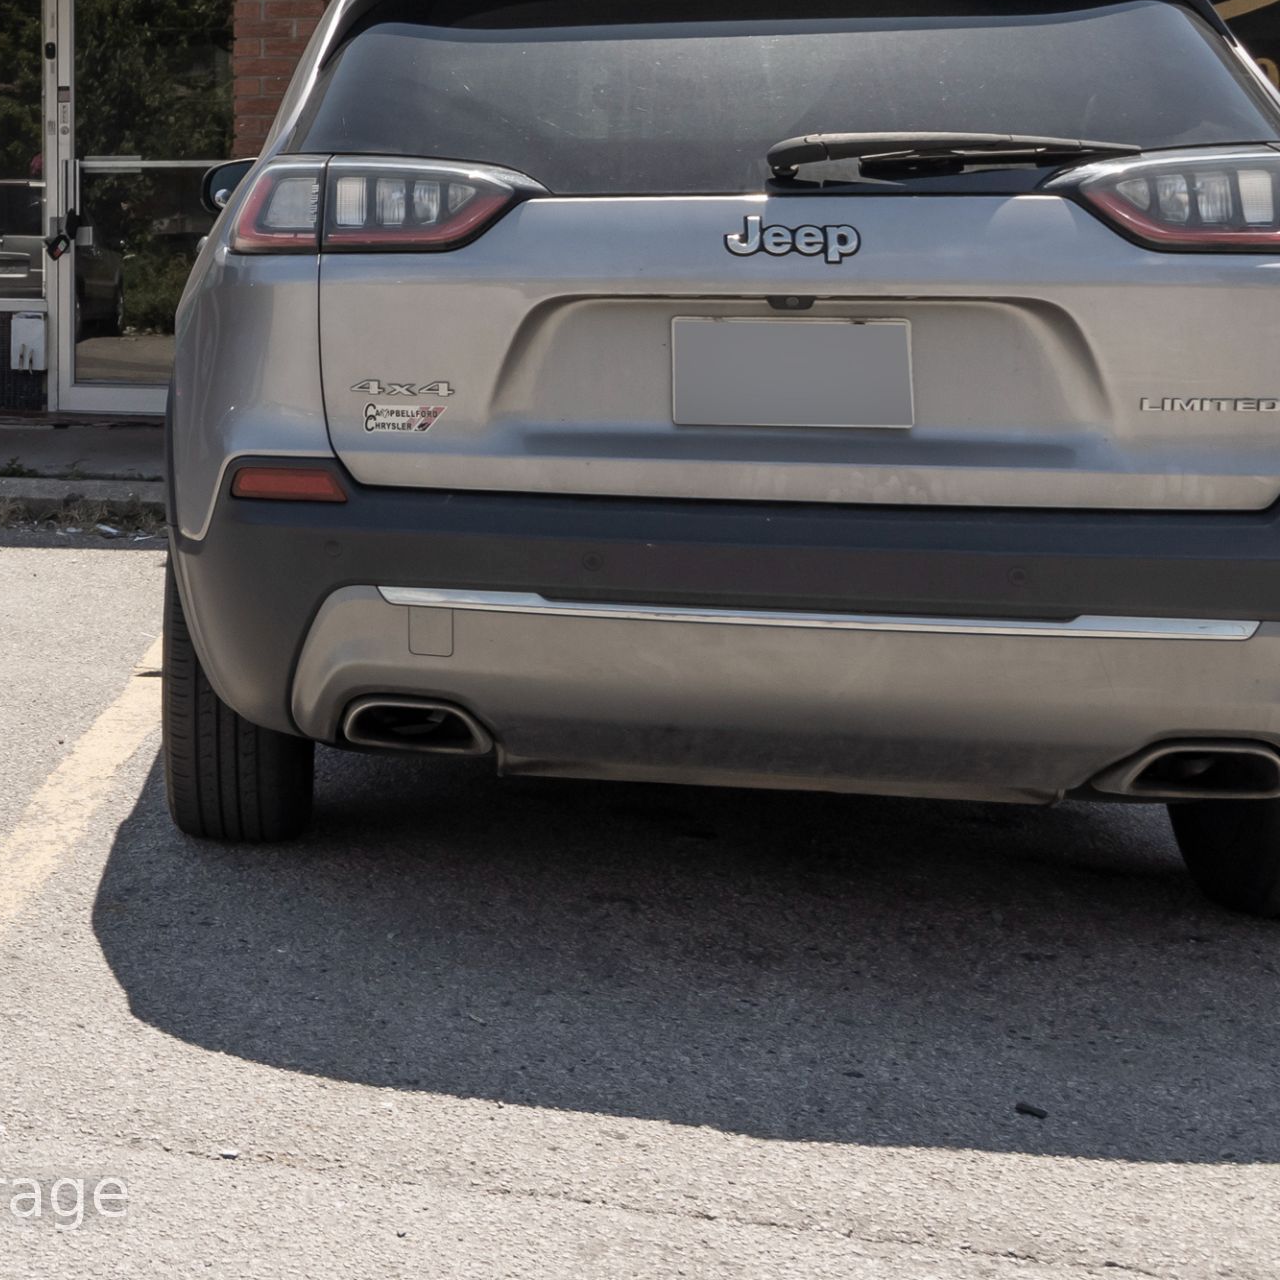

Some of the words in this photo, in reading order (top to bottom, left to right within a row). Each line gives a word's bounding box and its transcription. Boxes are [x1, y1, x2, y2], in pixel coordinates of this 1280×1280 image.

[723, 215, 861, 264] Jeep
[1139, 397, 1280, 412] LIMITED
[364, 415, 413, 432] CHRYSLER
